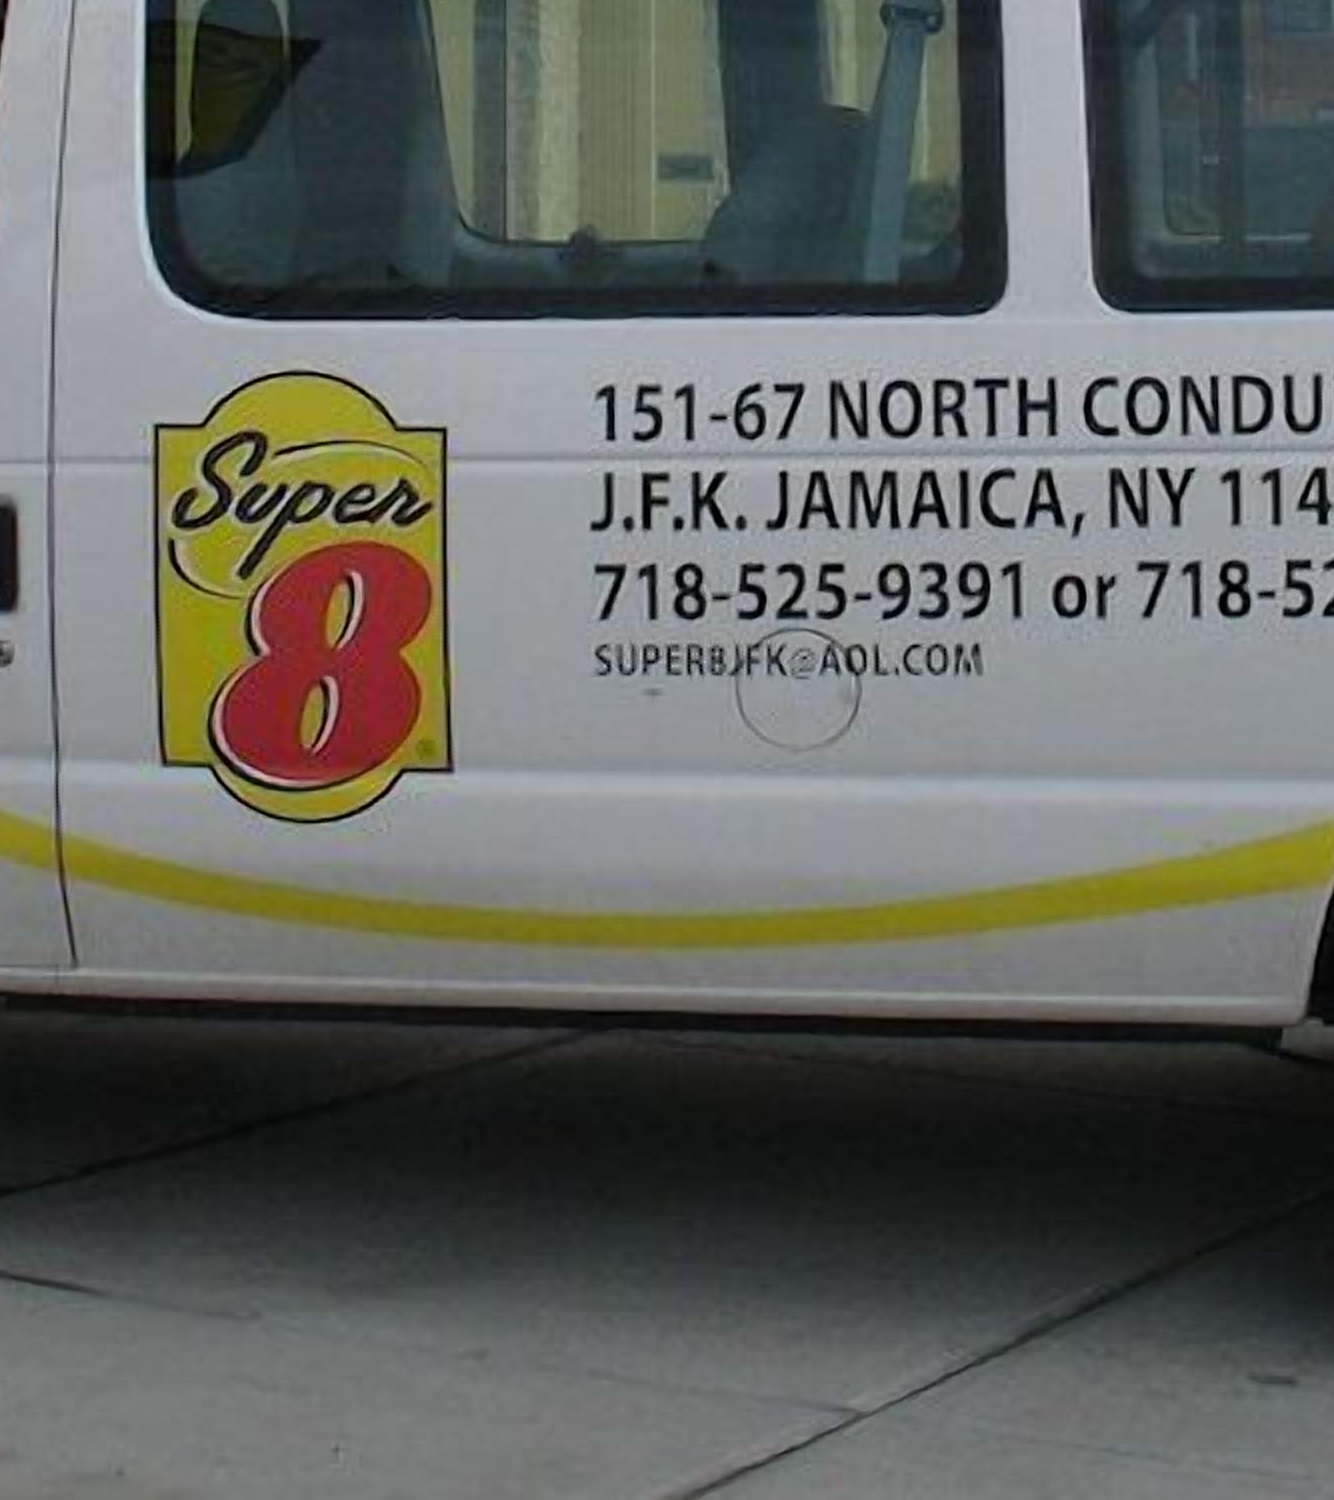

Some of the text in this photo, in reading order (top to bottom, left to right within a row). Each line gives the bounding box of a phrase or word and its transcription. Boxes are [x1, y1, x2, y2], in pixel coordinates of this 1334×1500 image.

[594, 382, 806, 442] 151-67
[829, 377, 1058, 440] NORTH
[171, 431, 433, 580] Super
[590, 470, 748, 532] J.F.K.
[766, 467, 1085, 537] JAMAICA,
[1108, 467, 1196, 528] NY
[593, 561, 1023, 621] 718-525-9391
[1051, 574, 1117, 619] or
[208, 541, 431, 790] 8
